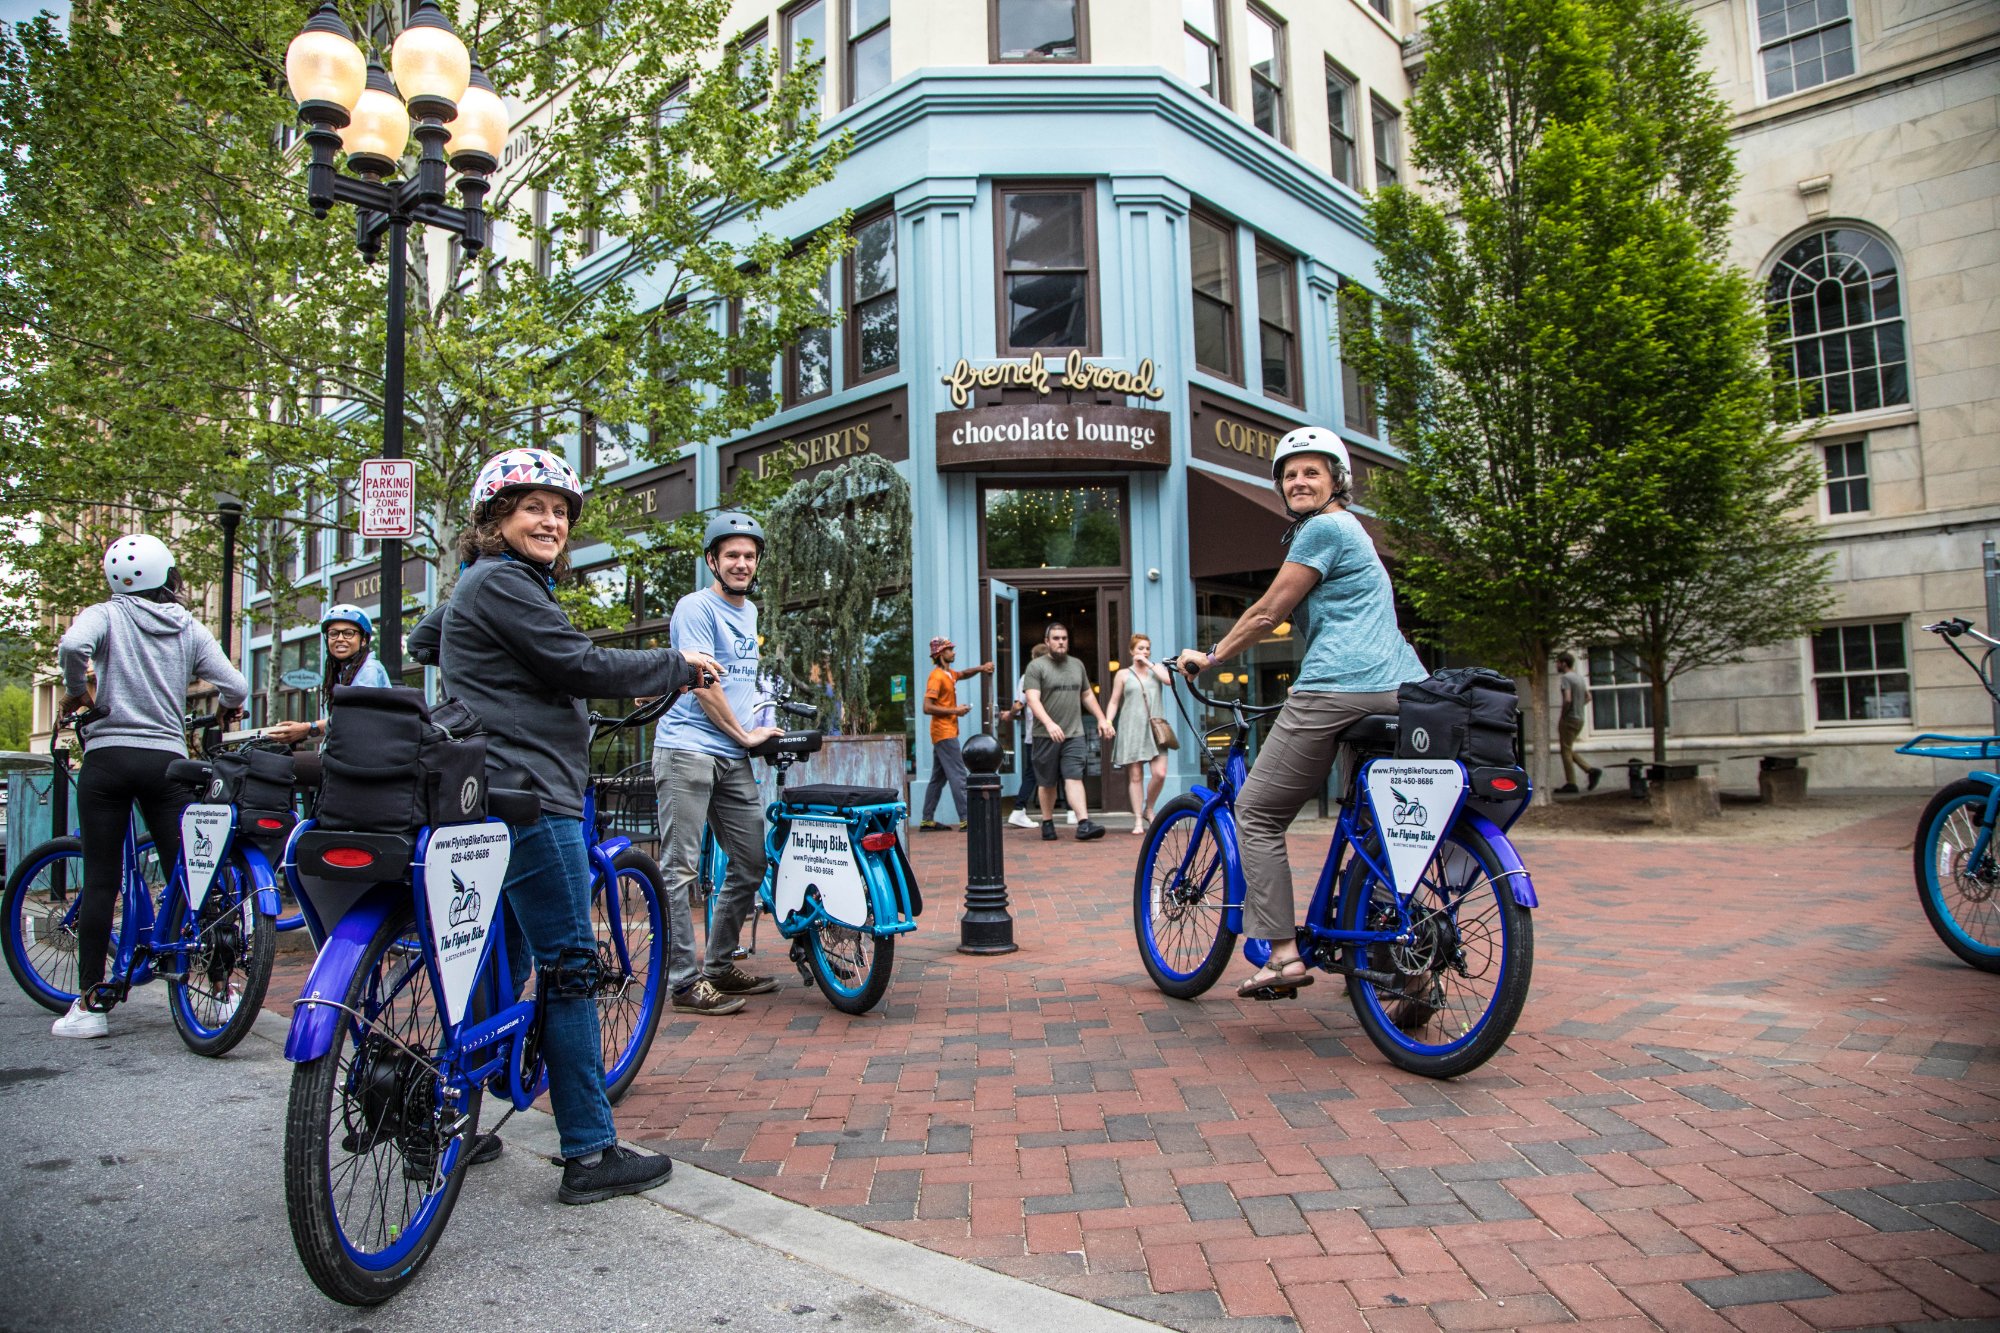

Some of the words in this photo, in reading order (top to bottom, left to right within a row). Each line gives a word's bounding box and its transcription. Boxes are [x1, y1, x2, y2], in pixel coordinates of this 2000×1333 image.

[943, 351, 1050, 407] french
[1062, 349, 1164, 399] broad
[952, 416, 1070, 446] chocolate
[1076, 416, 1156, 450] lounge
[380, 464, 396, 476] NO
[366, 477, 410, 489] PARKING
[367, 489, 409, 499] LOADING
[375, 498, 399, 507] ZONE
[369, 508, 383, 517] 30
[387, 508, 406, 516] MIN
[373, 516, 401, 525] LIMIT
[727, 664, 741, 674] The
[1372, 766, 1454, 775] www.FlyingBikeTours.com
[1390, 777, 1434, 785] 828-450-8686
[1387, 827, 1399, 838] The
[1399, 828, 1419, 842] Flying
[1420, 830, 1436, 841] Bike
[434, 832, 508, 850] www.FlyingBikeTours.com
[791, 831, 804, 848] The
[805, 833, 828, 854] Flying
[829, 835, 848, 852] Bike
[450, 848, 490, 864] 828-450-8686
[793, 854, 849, 867] www.FlyingBikeTours.com
[804, 865, 834, 876] 828-450-8686
[440, 936, 452, 952] The
[451, 929, 471, 950] Flying
[471, 924, 486, 941] Bike
